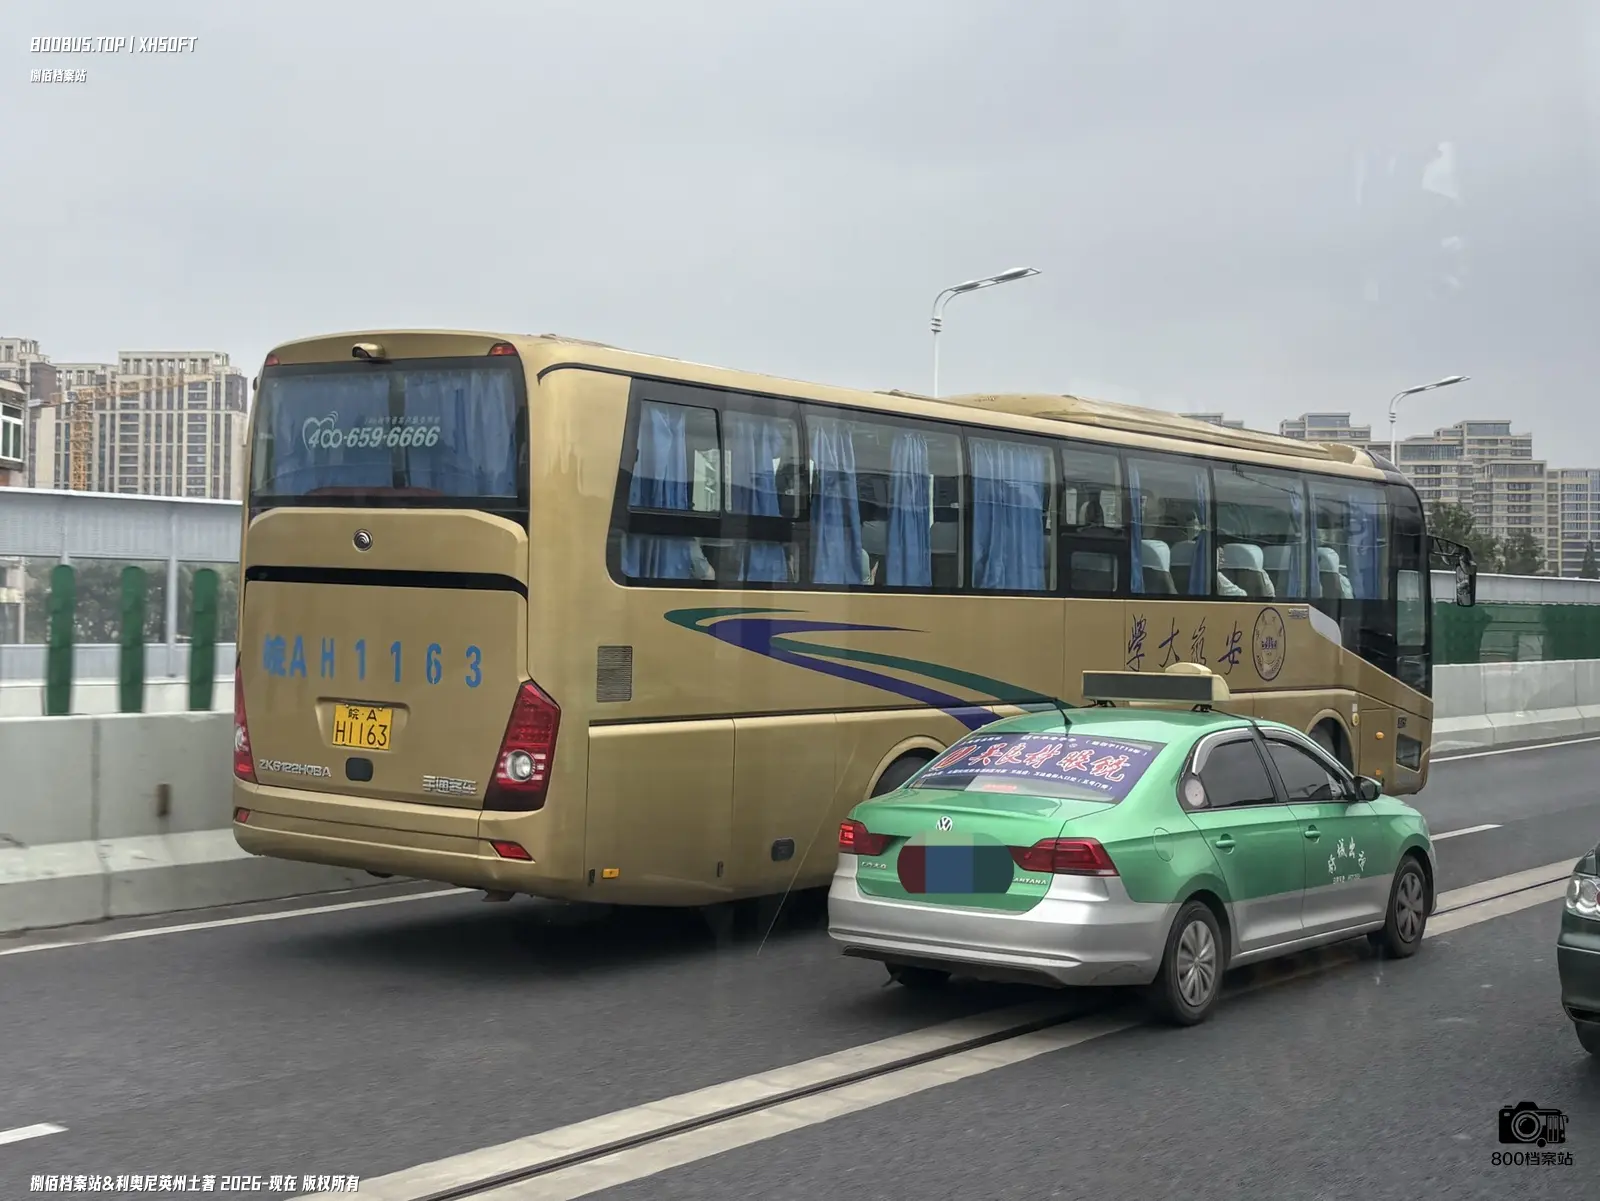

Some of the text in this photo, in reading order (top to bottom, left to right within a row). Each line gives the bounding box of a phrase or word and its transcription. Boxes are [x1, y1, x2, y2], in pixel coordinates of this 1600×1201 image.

[308, 426, 441, 449] 400-659-6666
[334, 720, 388, 747] H1163
[1012, 877, 1048, 886] ANTANA
